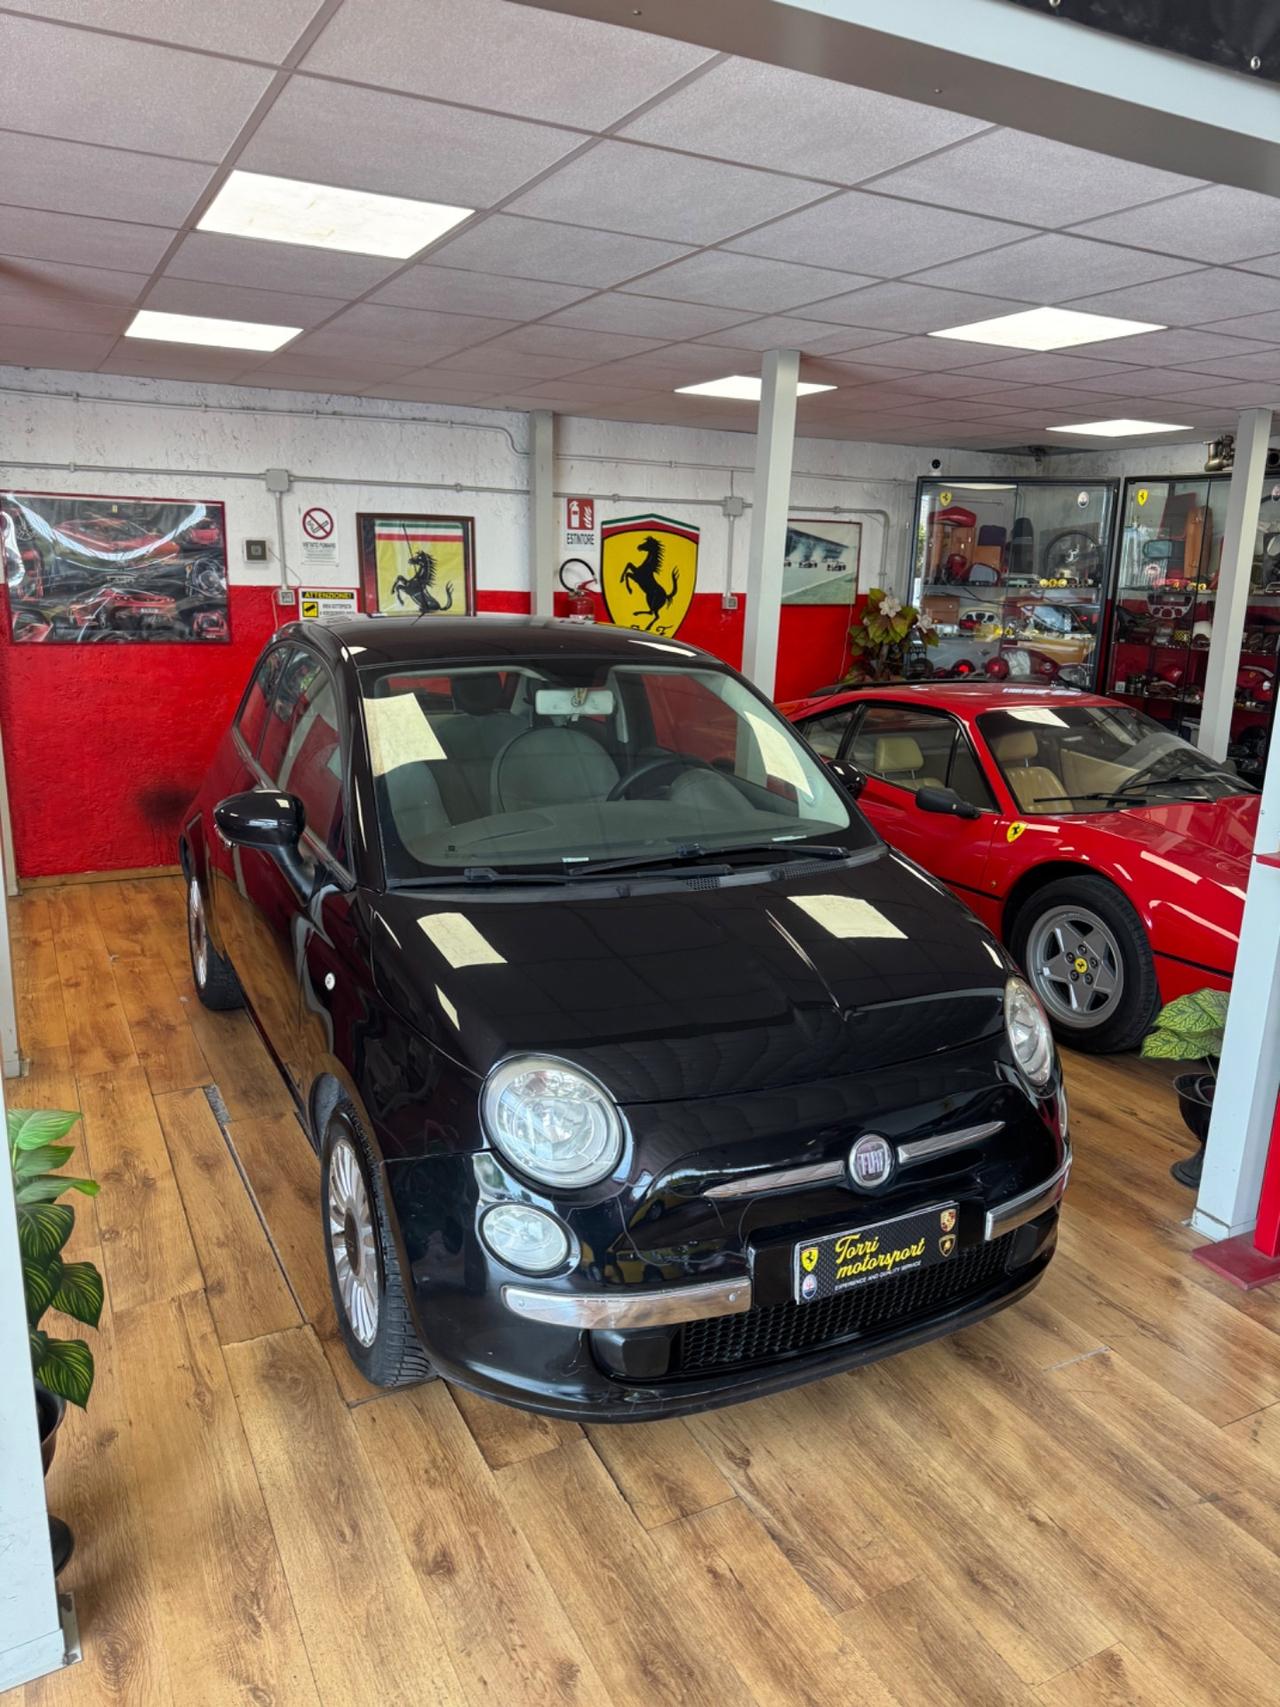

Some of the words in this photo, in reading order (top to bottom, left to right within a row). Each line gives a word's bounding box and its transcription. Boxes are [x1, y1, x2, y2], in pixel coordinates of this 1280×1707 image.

[566, 532, 594, 545] ESTINTORE
[856, 1149, 884, 1176] FIAT
[835, 1233, 880, 1264] Torri
[836, 1237, 926, 1280] motorsport
[834, 1277, 867, 1291] EXPERIENCE
